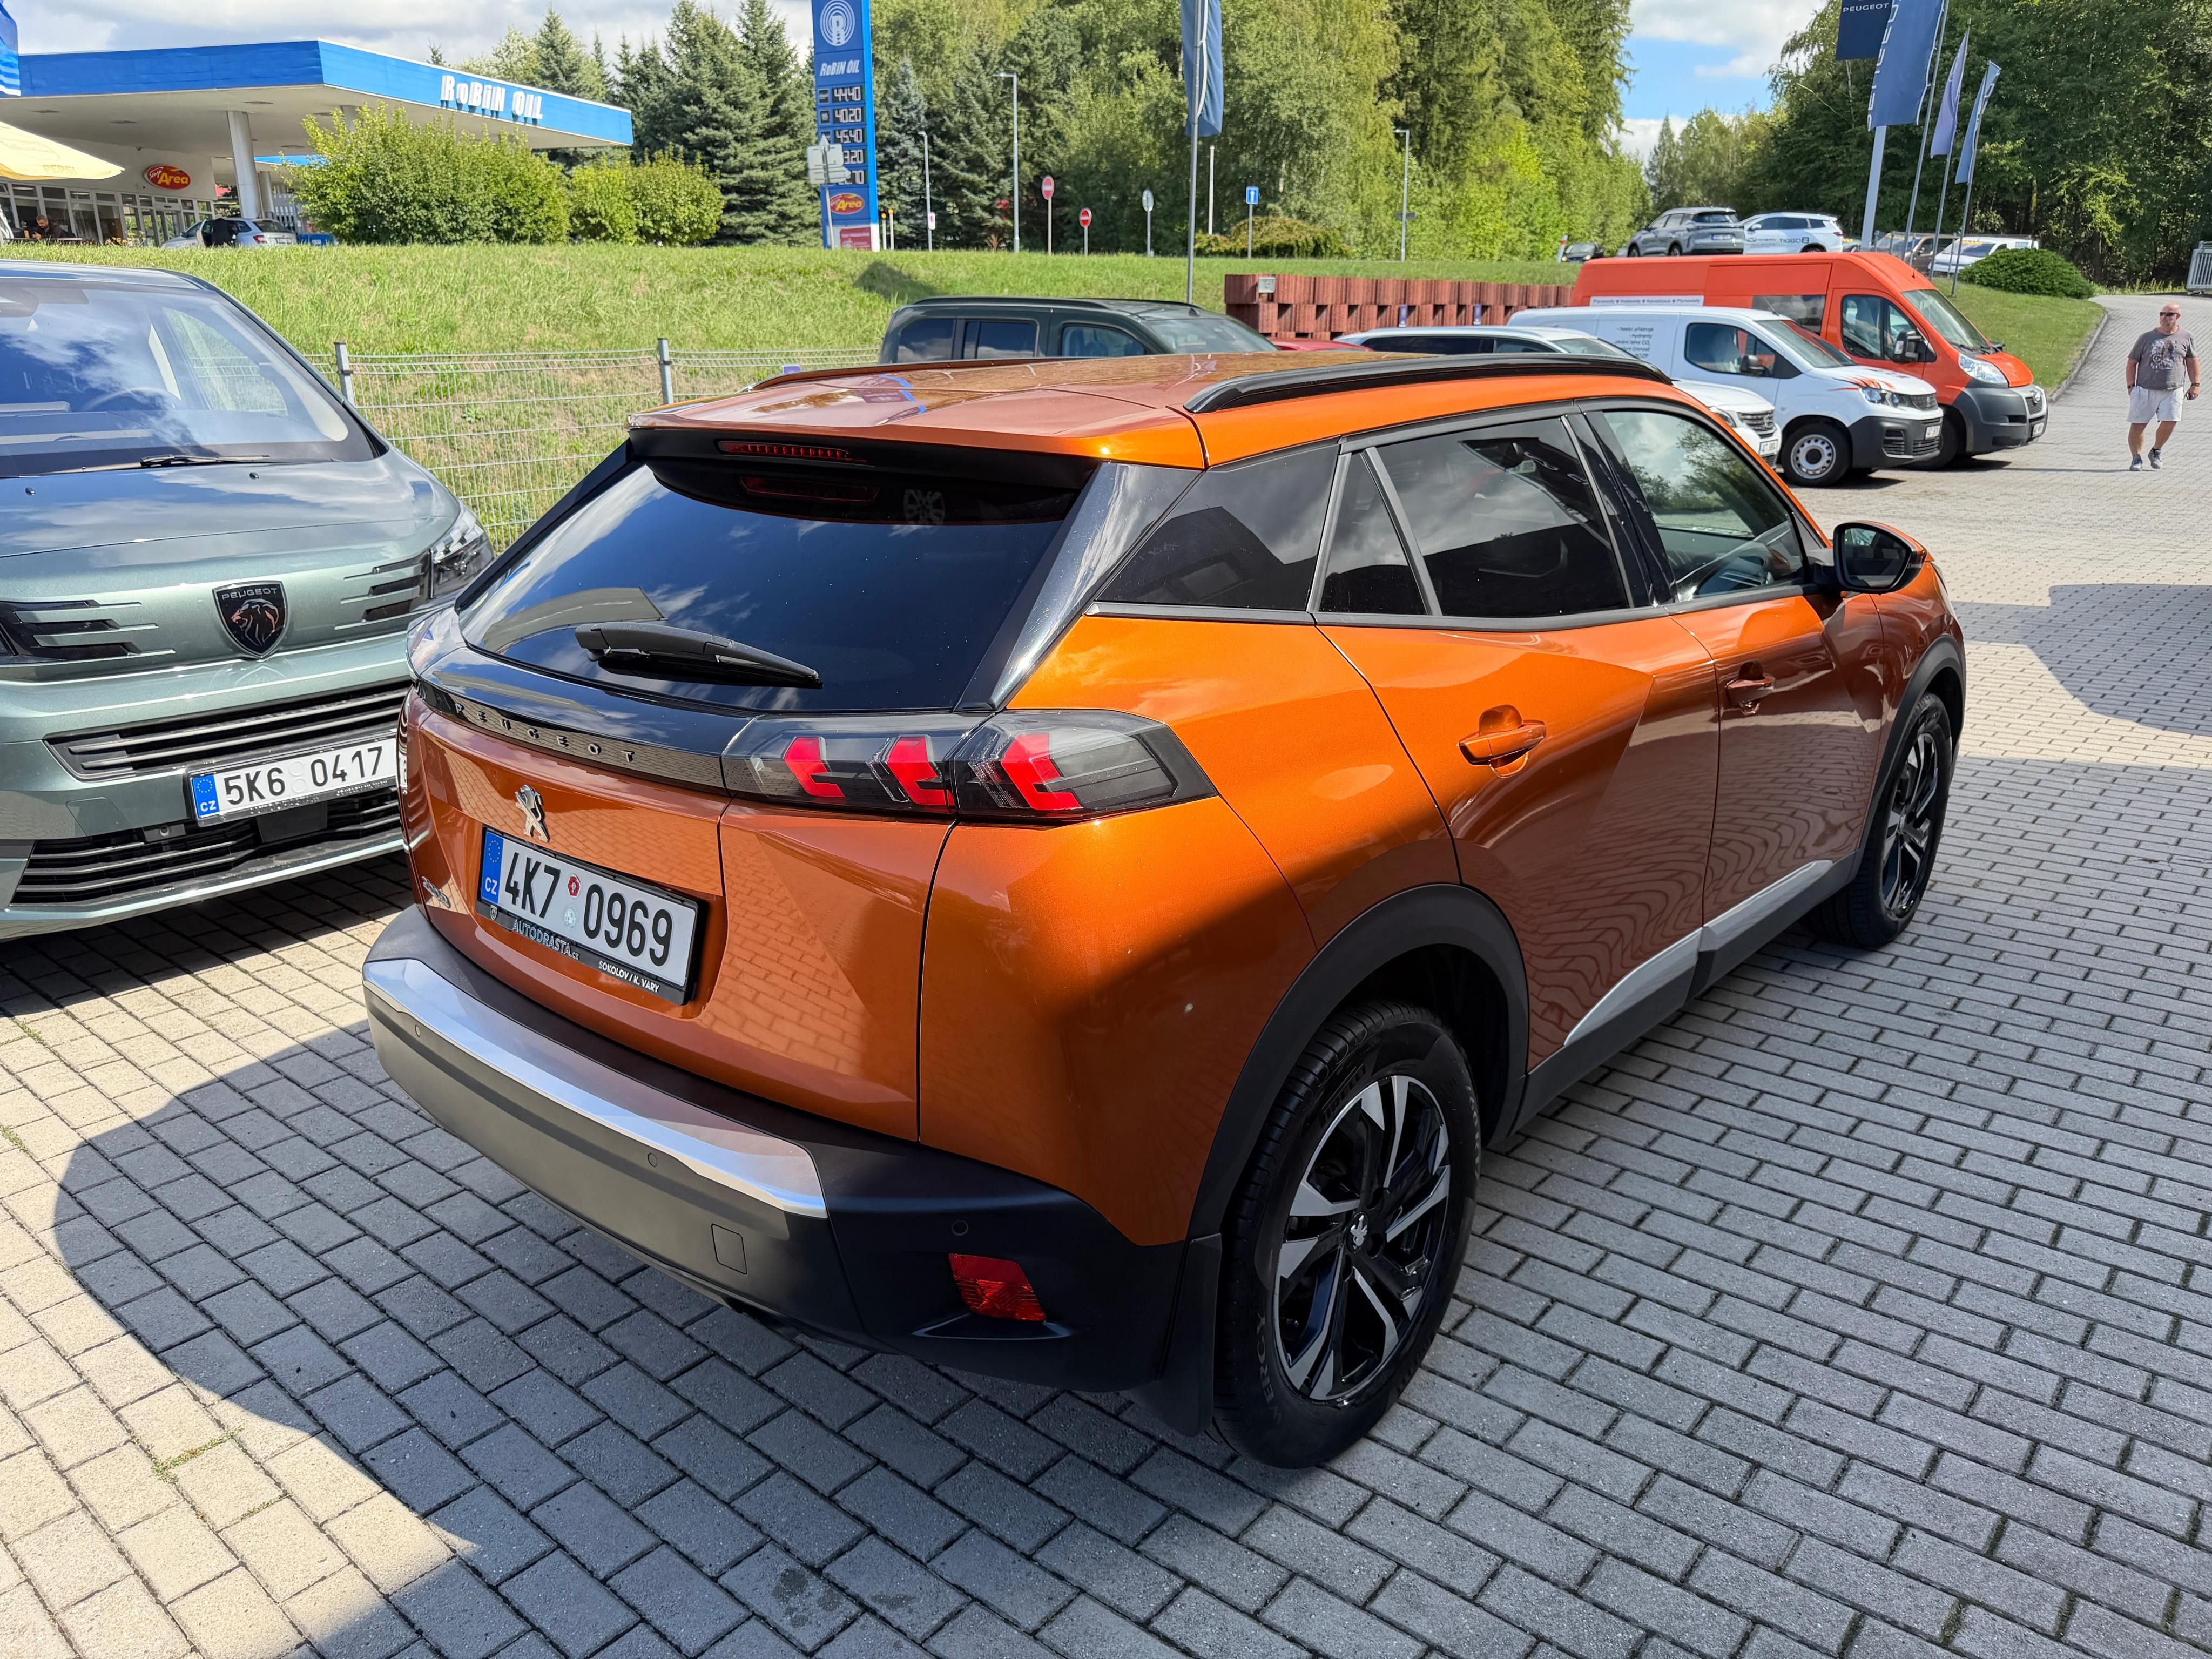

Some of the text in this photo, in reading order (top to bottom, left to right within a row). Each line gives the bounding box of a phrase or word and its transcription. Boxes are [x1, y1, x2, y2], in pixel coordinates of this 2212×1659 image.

[1843, 3, 1890, 12] PEUGEOT
[846, 60, 860, 73] OIL
[511, 91, 543, 119] OIL
[157, 172, 188, 185] Area
[835, 200, 862, 211] Area
[221, 588, 277, 601] PEUGEOT
[455, 702, 636, 763] PEUGEOT
[224, 767, 286, 805] 5K6
[310, 746, 383, 787] 0417
[200, 800, 217, 813] CZ
[484, 876, 497, 895] CZ
[504, 852, 673, 967] 4K7 0969
[598, 960, 630, 980] SOKOLOV
[641, 979, 660, 993] VARY
